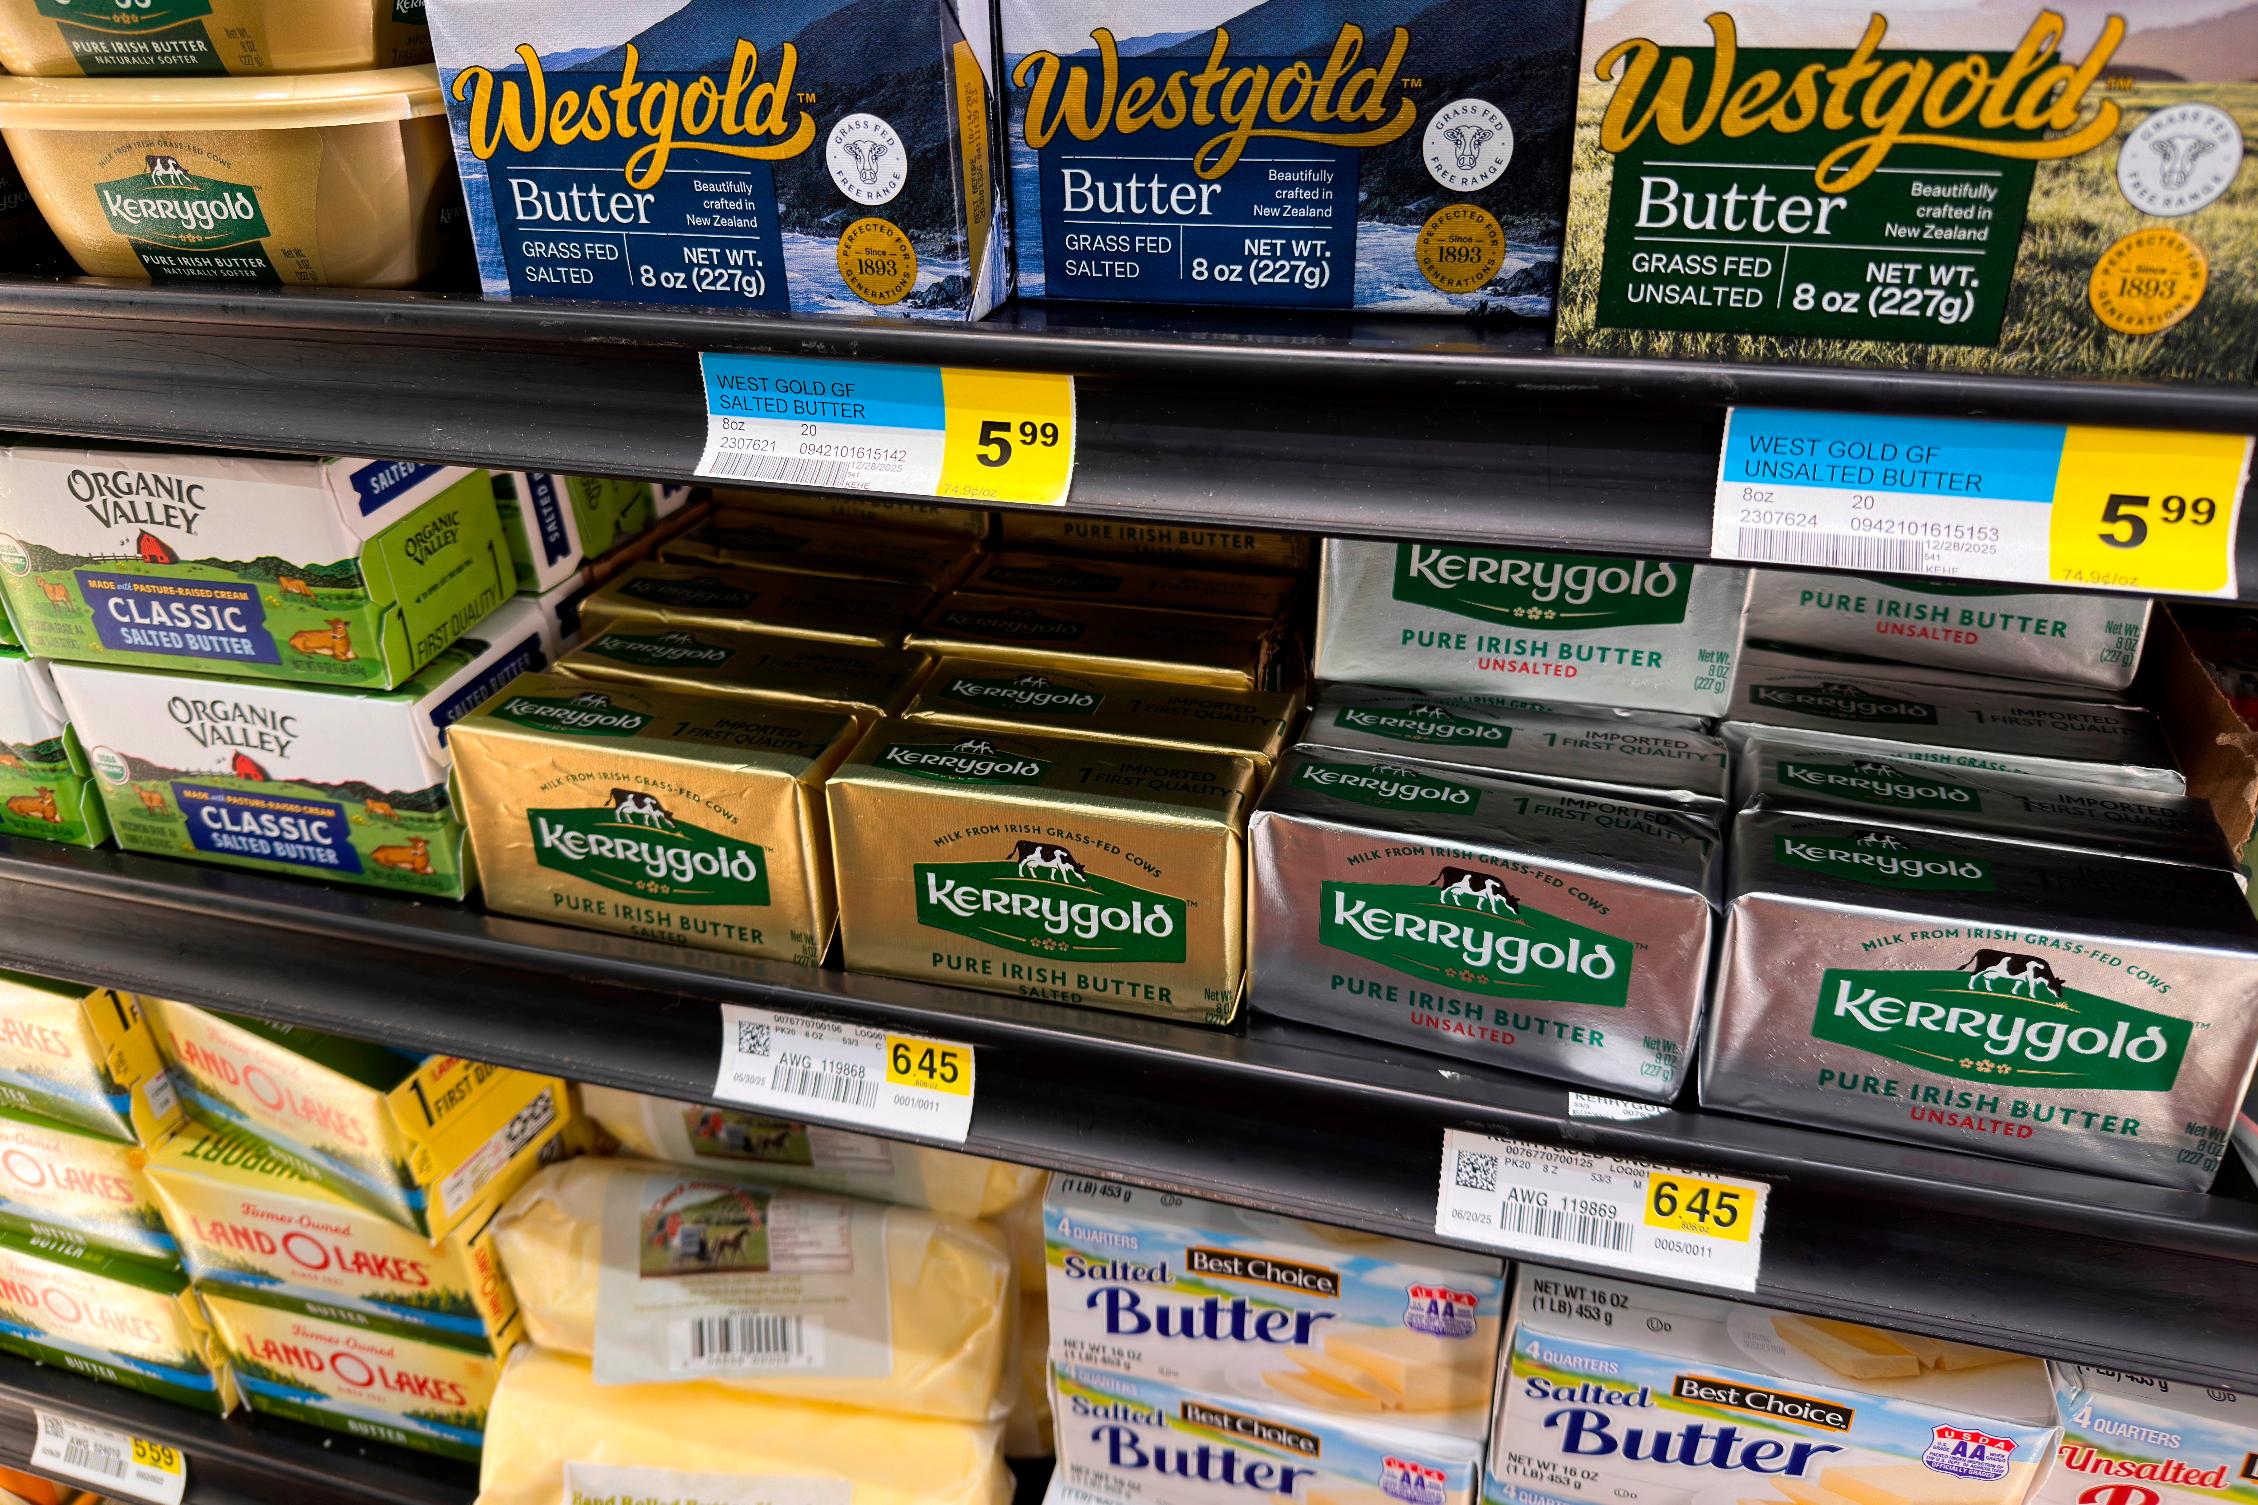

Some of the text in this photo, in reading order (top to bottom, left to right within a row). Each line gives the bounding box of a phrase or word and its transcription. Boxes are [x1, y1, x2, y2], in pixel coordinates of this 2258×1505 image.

[72, 40, 208, 53] PURE IRISH BUTTER
[452, 38, 816, 190] Westgold
[1012, 20, 1417, 180] Westgold
[1594, 9, 2125, 194] Westgold
[835, 121, 895, 146] GRASS FED
[694, 180, 752, 196] Beautifully
[836, 170, 901, 199] FREE RANGE
[1269, 170, 1334, 184] Beautifully
[508, 179, 654, 224] Butter
[703, 198, 755, 211] crafted in
[1061, 168, 1221, 216] Butter
[1275, 188, 1333, 200] crafted in
[1635, 176, 1847, 236] Butter
[687, 214, 757, 228] New Zealand
[1253, 205, 1332, 218] New Zealand
[522, 242, 618, 261] GRASS FED
[843, 224, 910, 259] PERFECTED FOR
[865, 248, 886, 256] Since
[1066, 234, 1172, 253] GRASS FED
[1244, 239, 1331, 258] NET WT.
[142, 255, 266, 268] PURE IRISH BUTTER
[684, 248, 762, 266] NET WT.
[857, 259, 897, 275] 1893
[1066, 261, 1139, 278] SALTED
[1632, 253, 1772, 279] GRASS FED
[526, 266, 593, 284] SALTED
[641, 266, 766, 297] 8 oz (227g)
[846, 270, 910, 299] GENERATIONS
[1192, 259, 1330, 288] 8 oz (227g)
[1866, 262, 1979, 288] NET WT.
[1628, 282, 1763, 310] UNSALTED
[1792, 284, 1975, 324] 8 oz (227g)
[717, 375, 856, 396] WEST GOLD GF
[720, 395, 866, 419] SALTED BUTTER
[723, 417, 816, 436] 8oz 20
[720, 436, 907, 463] 2307621 0942101615142
[1749, 434, 1941, 465] WEST GOLD GF
[67, 468, 206, 511] ORGANIC
[1745, 459, 1983, 493] UNSALTED BUTTER
[1742, 487, 1875, 511] 8oz 20
[86, 498, 200, 535] VALLEY
[1740, 508, 2000, 543] 2307624 0942101615153
[1925, 540, 1997, 555] 12/28/2025
[87, 578, 116, 592] MADE
[133, 583, 211, 598] PASTURE-RAISED
[213, 589, 249, 601] CREAM
[108, 598, 248, 633] CLASSIC
[1801, 590, 2068, 639] PURE IRISH BUTTER
[120, 627, 256, 656] SALTED BUTTER
[1402, 629, 1663, 668] PURE IRISH BUTTER
[1478, 658, 1578, 678] UNSALTED
[167, 696, 299, 738] ORGANIC
[187, 723, 294, 758] VALLEY
[201, 805, 333, 844] CLASSIC
[211, 832, 338, 864] SALTED BUTTER
[933, 824, 1163, 878] MILK FROM IRISH GRASS-FED COWS
[554, 893, 764, 944] PURE IRISH BUTTER
[932, 952, 1173, 1003] PURE IRISH BUTTER
[1331, 975, 1605, 1048] PURE IRISH BUTTER
[1410, 1012, 1517, 1046] UNSALTED
[780, 1052, 865, 1079] AWG 119868
[894, 1095, 940, 1111] 0001/0011
[1818, 1068, 2141, 1137] PURE IRISH BUTTER
[1910, 1106, 2034, 1140] UNSALTED
[1451, 1209, 1492, 1225] 06/20/25
[1507, 1187, 1617, 1219] AWG 119869
[192, 1216, 430, 1287] LAND O LAKES
[1655, 1237, 1713, 1258] 0005/0011
[1065, 1256, 1175, 1284] Salted
[1192, 1251, 1252, 1275] Best
[1087, 1287, 1336, 1345] Butter
[245, 1334, 468, 1407] LAND O LAKES
[1543, 1351, 1619, 1374] QUARTERS
[1524, 1378, 1655, 1408] Salted
[1680, 1380, 1743, 1403] Best
[1543, 1408, 1846, 1478] Butter
[2094, 1419, 2181, 1448] QUARTERS
[2058, 1445, 2229, 1488] Unsalted
